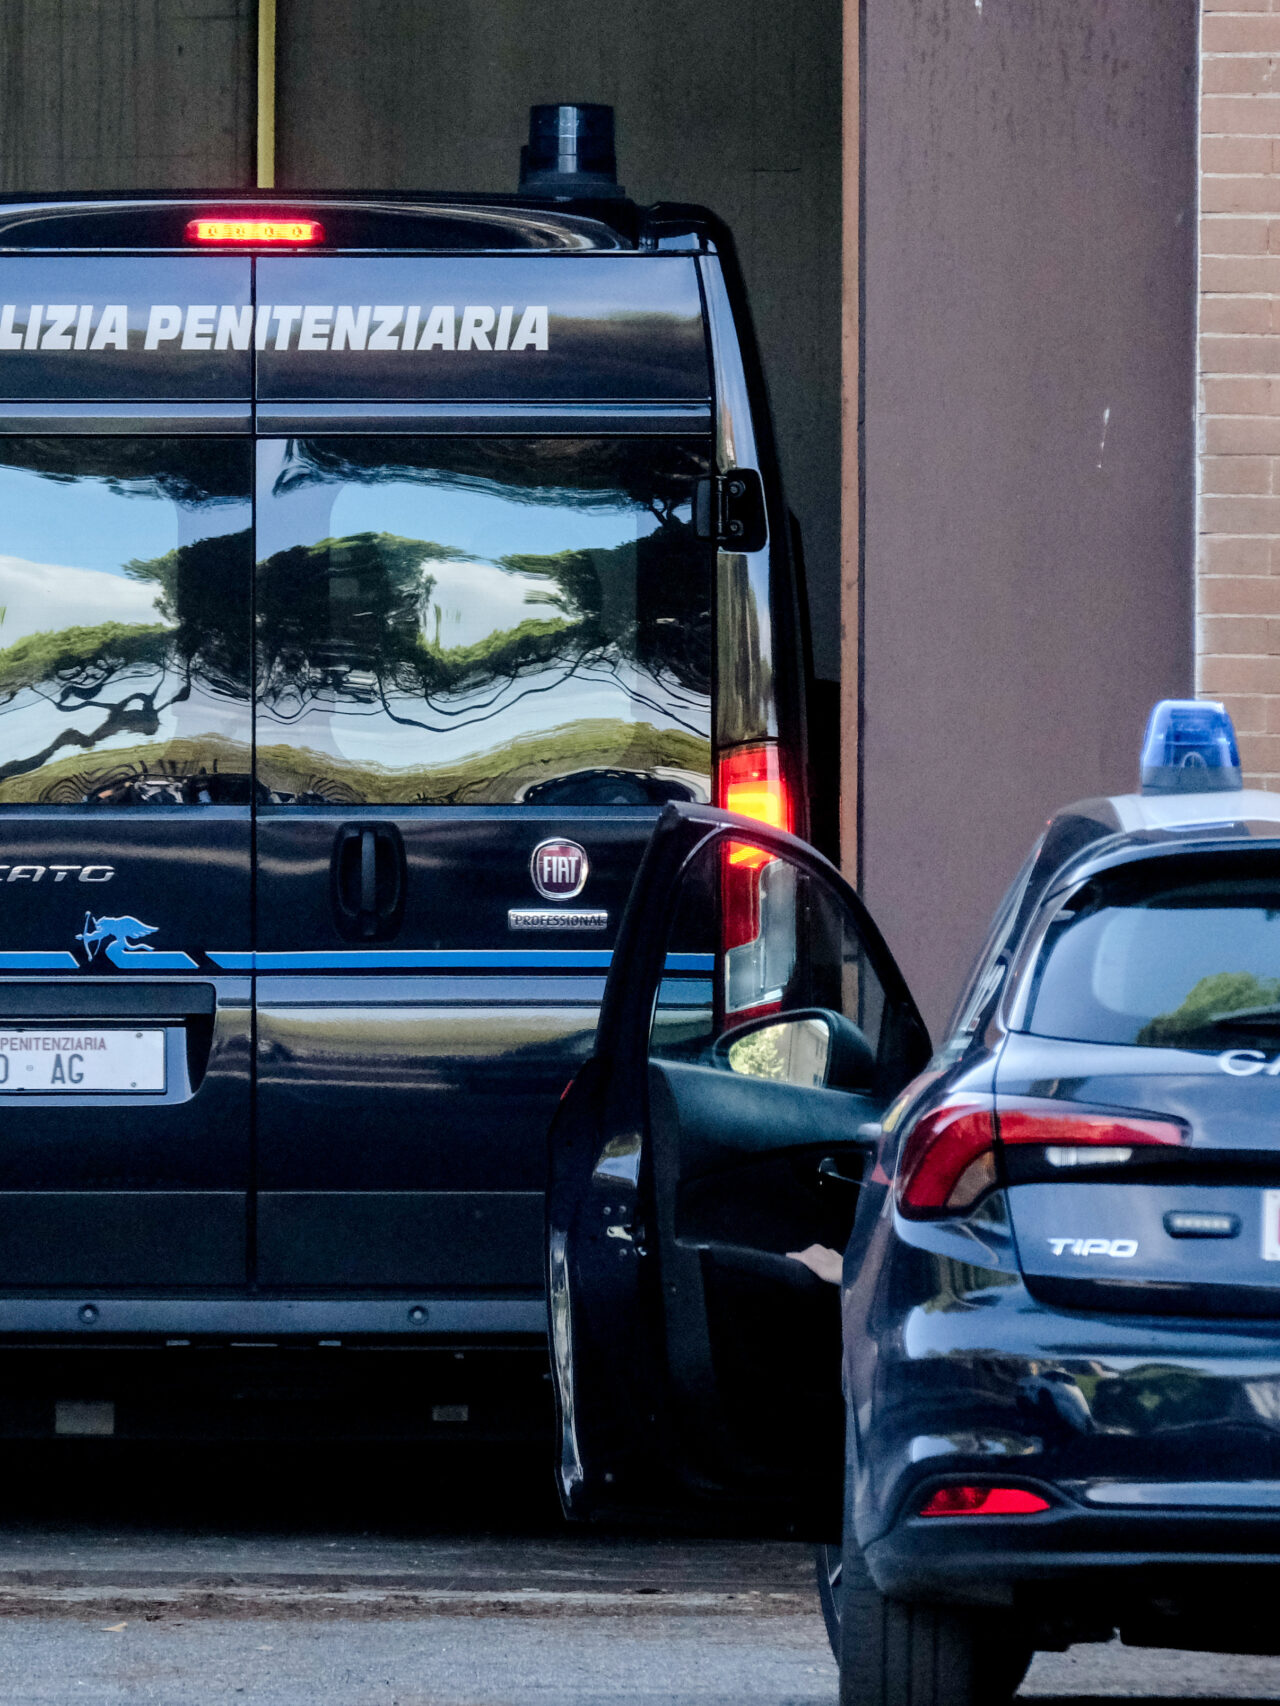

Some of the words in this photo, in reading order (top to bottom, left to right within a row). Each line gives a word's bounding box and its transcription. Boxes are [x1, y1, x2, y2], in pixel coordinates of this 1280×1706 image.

[144, 304, 549, 351] PENITENZIARIA
[543, 856, 579, 883] FIAT
[515, 915, 606, 926] PROFESSIONAL
[0, 1037, 107, 1051] PENITENZIARIA
[50, 1054, 84, 1084] AG
[1219, 1049, 1280, 1076] C
[1048, 1238, 1138, 1257] TIPO
